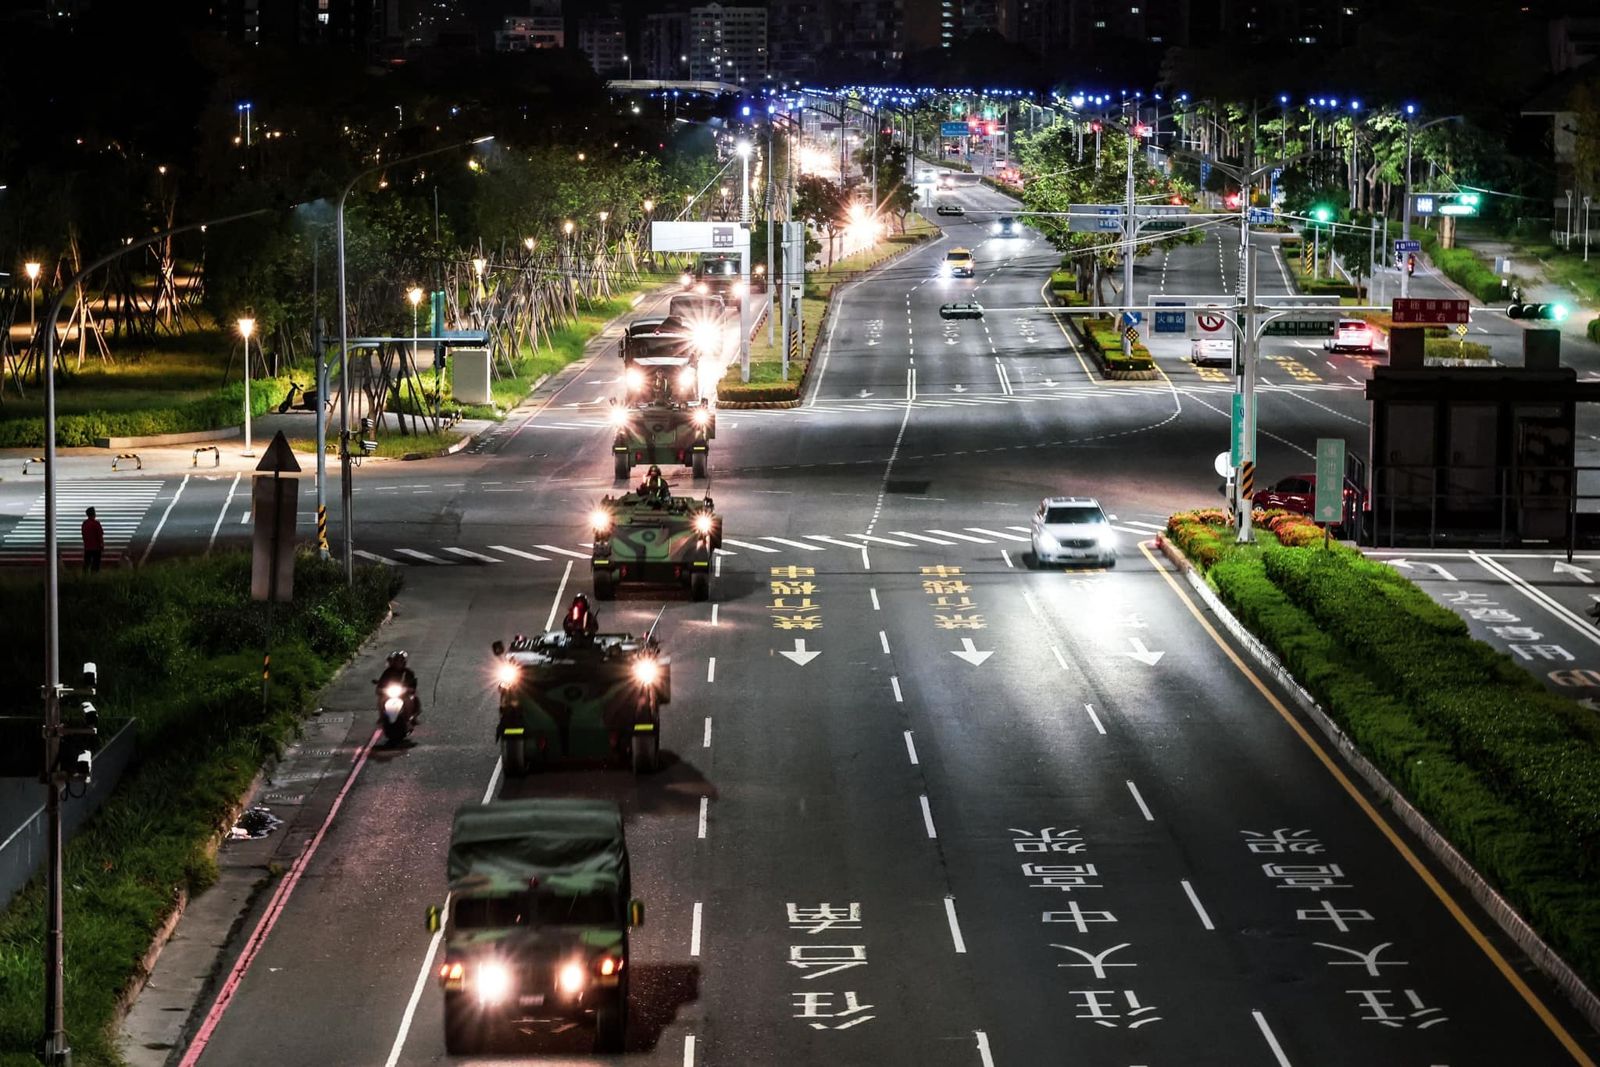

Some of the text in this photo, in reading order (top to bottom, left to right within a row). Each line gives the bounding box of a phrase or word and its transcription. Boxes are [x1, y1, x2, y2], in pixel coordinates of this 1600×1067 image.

[766, 565, 823, 630] 禁行機車
[919, 565, 986, 630] 禁行機車
[786, 903, 876, 1030] 往台南
[1008, 827, 1163, 1029] 往大中高架
[1239, 827, 1449, 1029] 往大中高架
